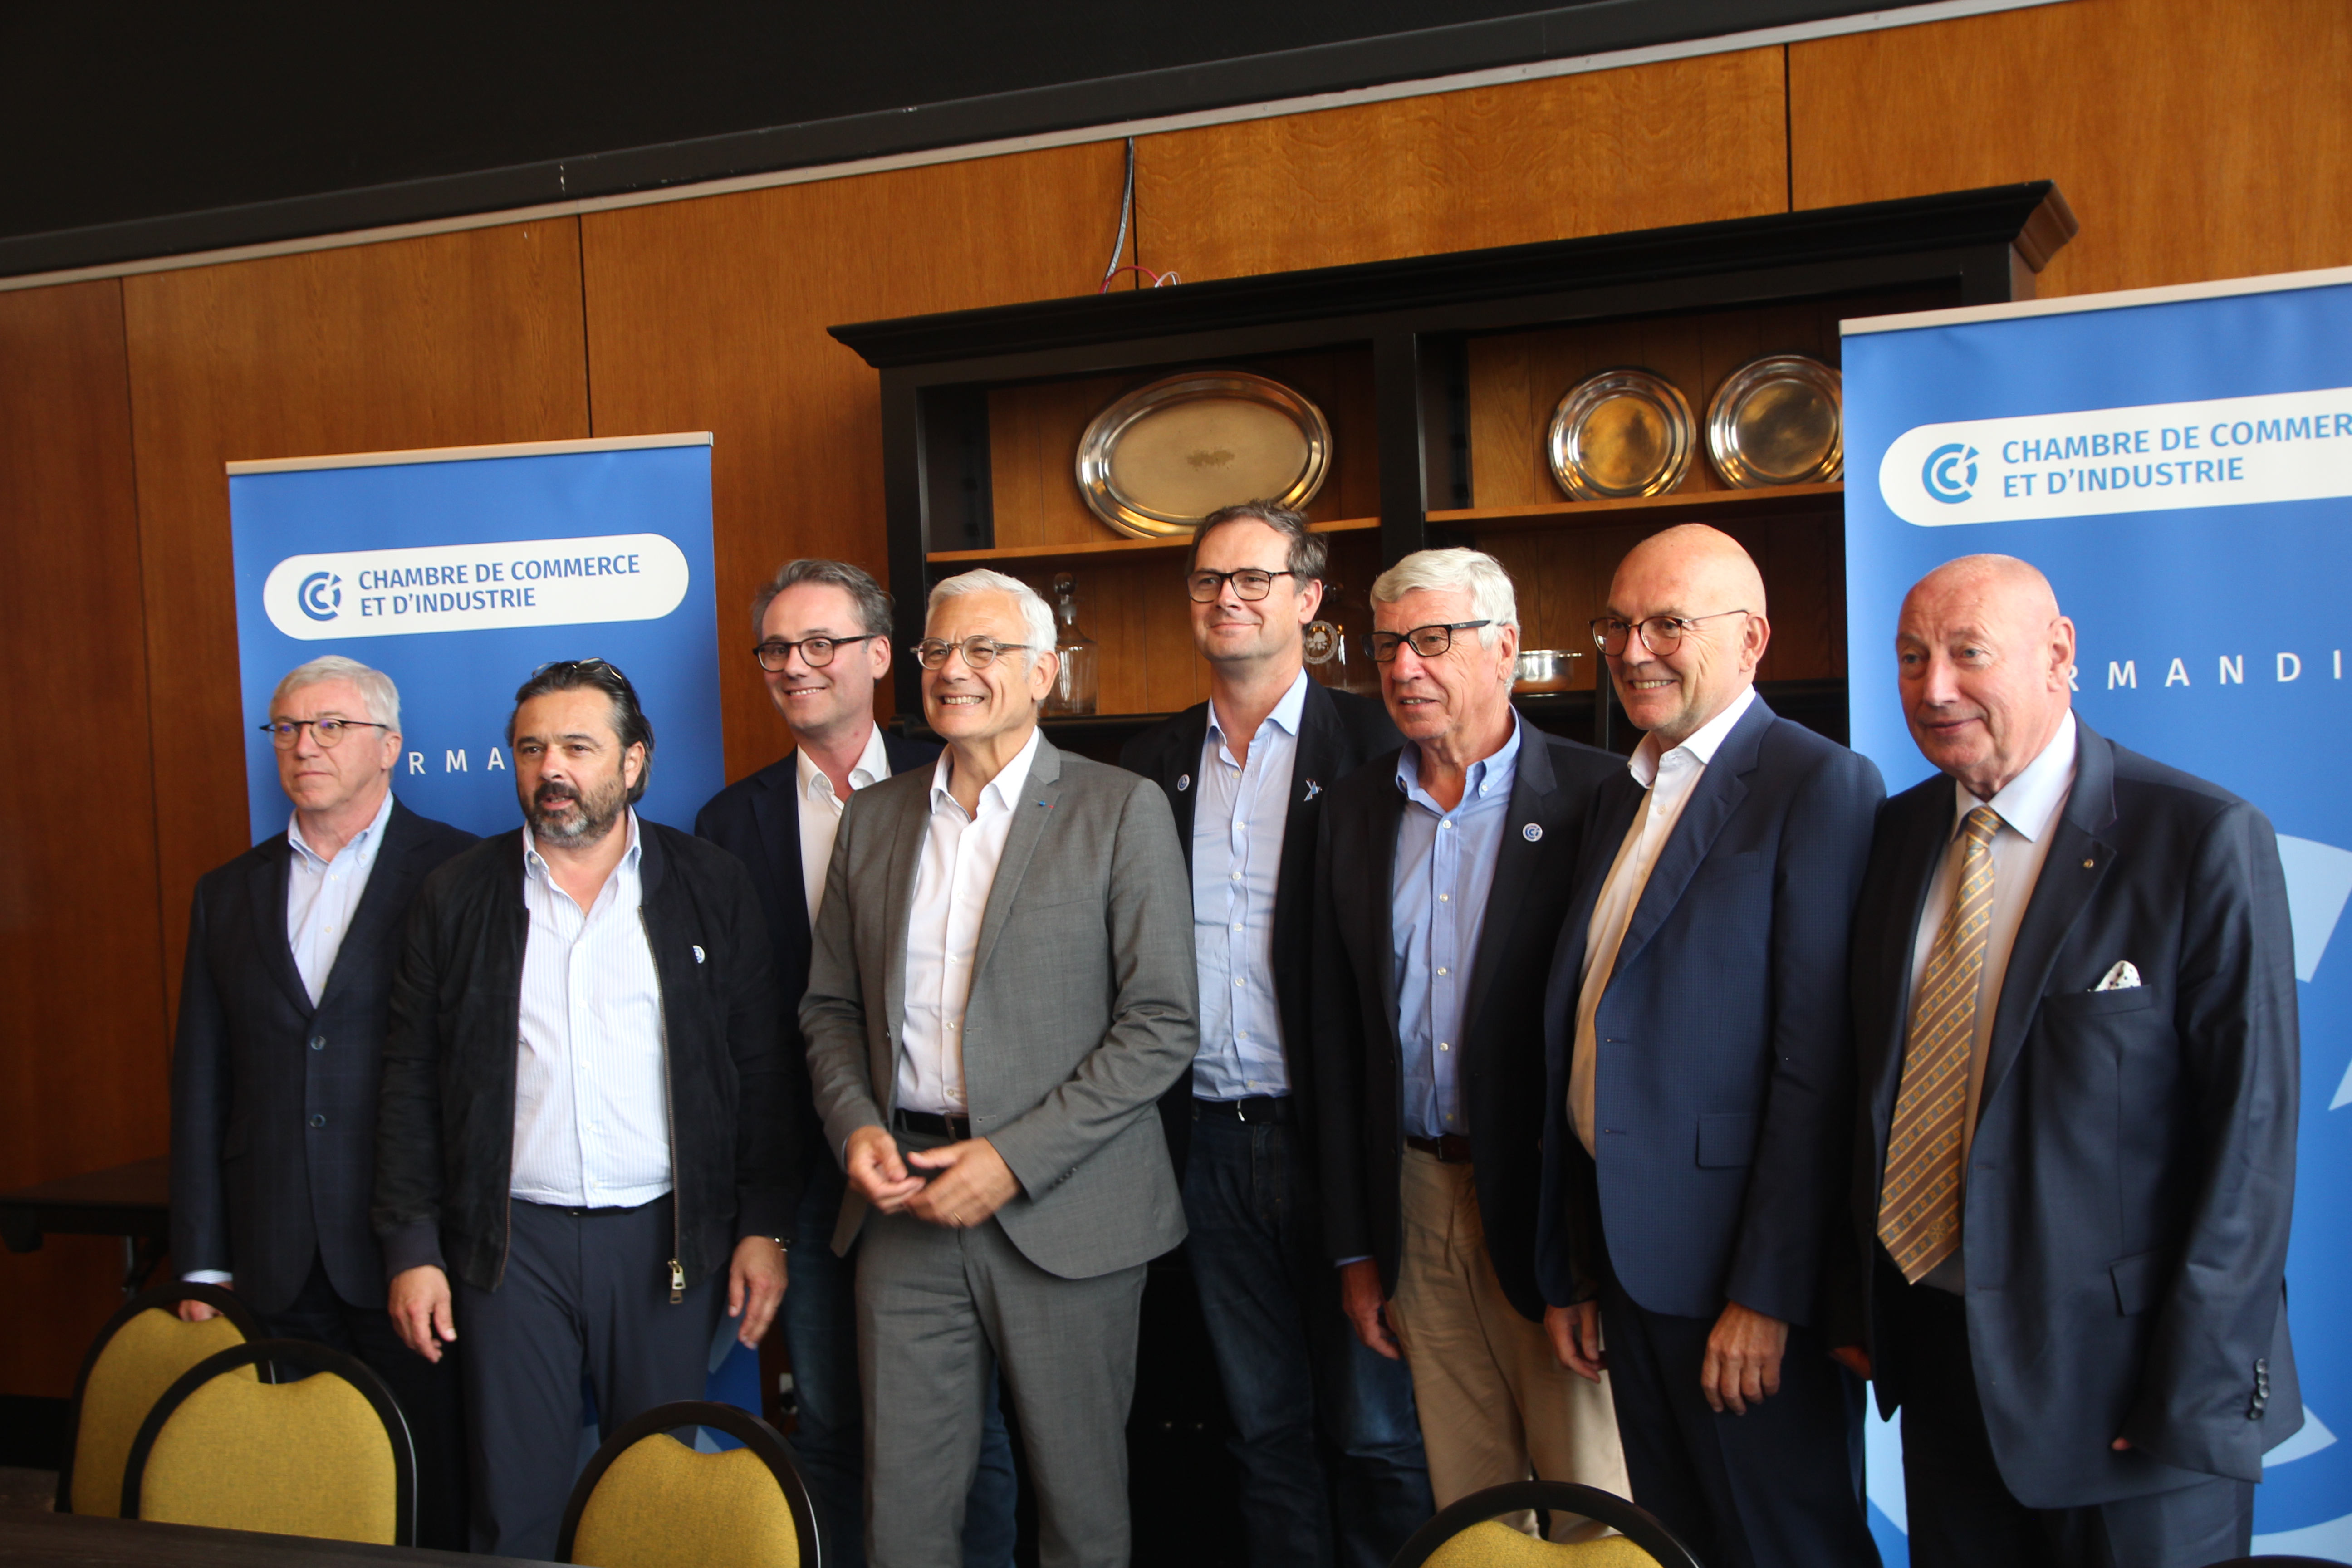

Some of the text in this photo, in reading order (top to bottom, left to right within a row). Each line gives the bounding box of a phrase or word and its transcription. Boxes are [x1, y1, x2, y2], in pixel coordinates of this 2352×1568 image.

[2003, 430, 2150, 464] CHAMBRE
[2161, 426, 2200, 451] DE
[2004, 457, 2244, 497] ET D'INDUSTRIE
[358, 554, 640, 590] CHAMBRE DE COMMERCE
[361, 588, 536, 616] ET D'INDUSTRIE
